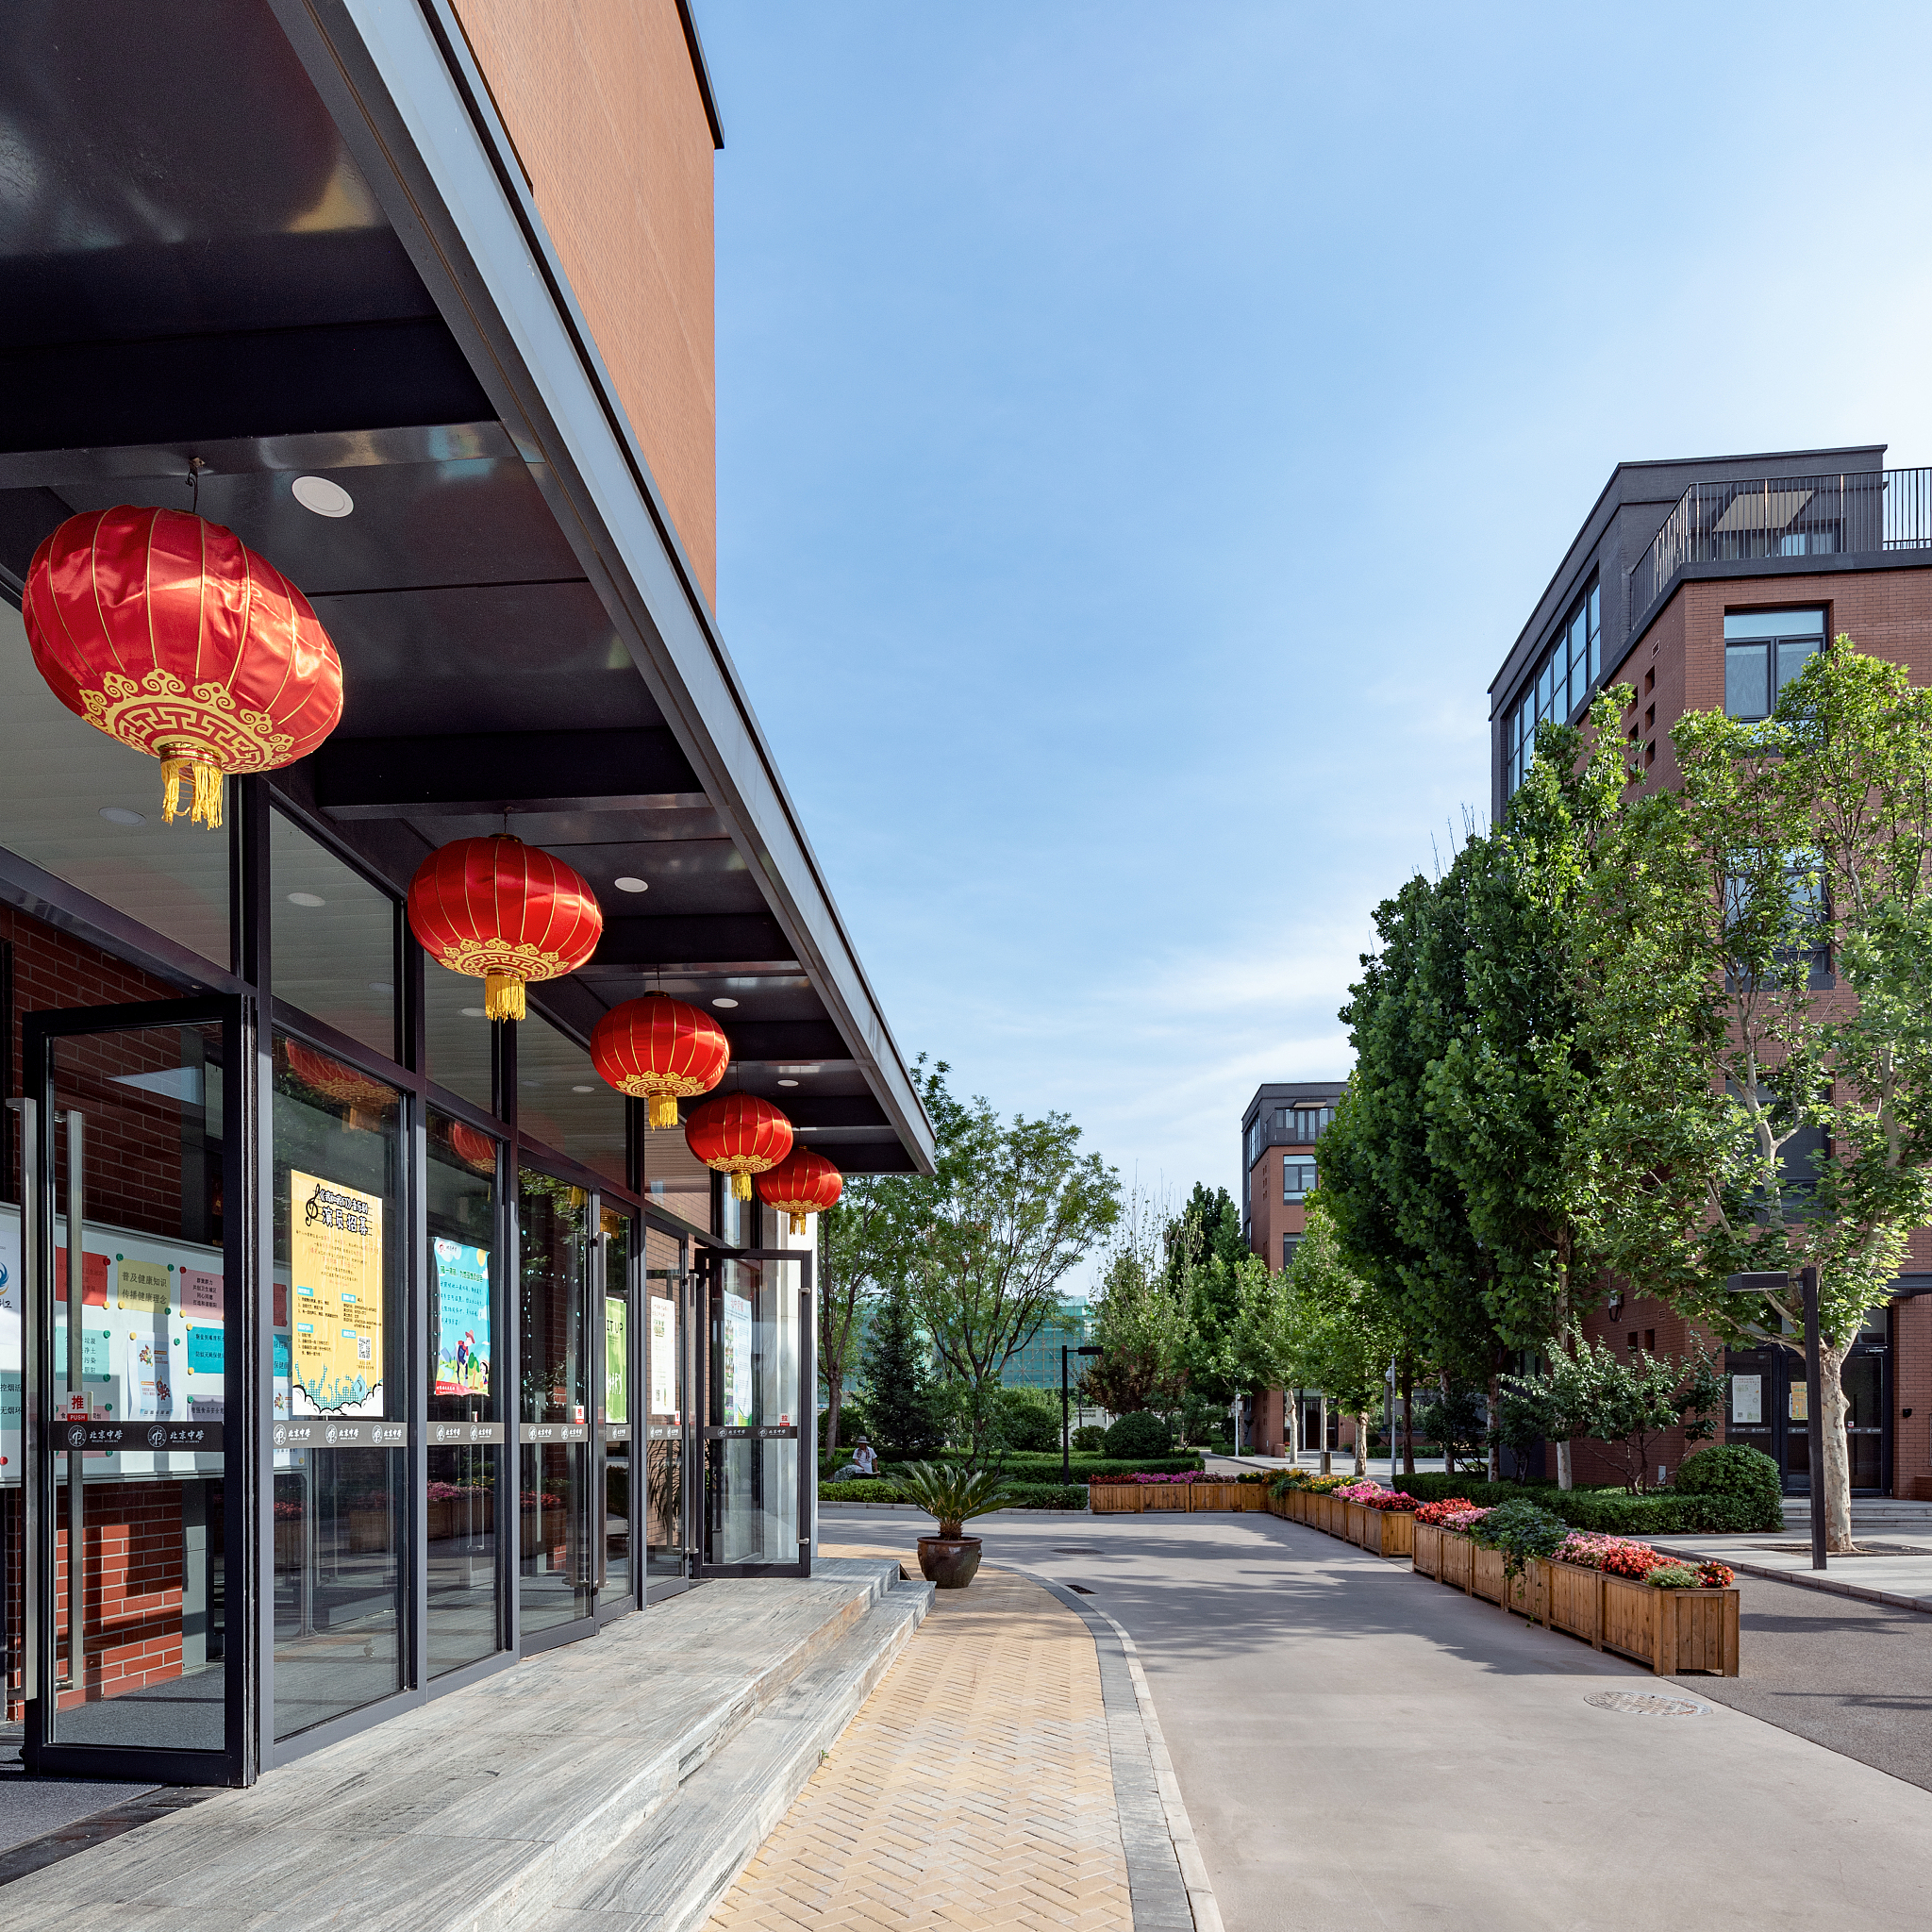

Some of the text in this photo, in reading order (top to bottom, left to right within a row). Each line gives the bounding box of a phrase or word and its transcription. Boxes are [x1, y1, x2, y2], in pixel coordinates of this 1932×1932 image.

[322, 1206, 368, 1236] 演员招募
[122, 1271, 167, 1288] 普及健康知识
[122, 1289, 167, 1305] 传播健康理念
[71, 1395, 84, 1409] 推
[89, 1429, 124, 1441] 北京中学
[170, 1430, 205, 1441] 北京中学
[288, 1427, 311, 1438] 北京中学
[339, 1427, 359, 1438] 北京中学
[383, 1428, 402, 1438] 北京中学
